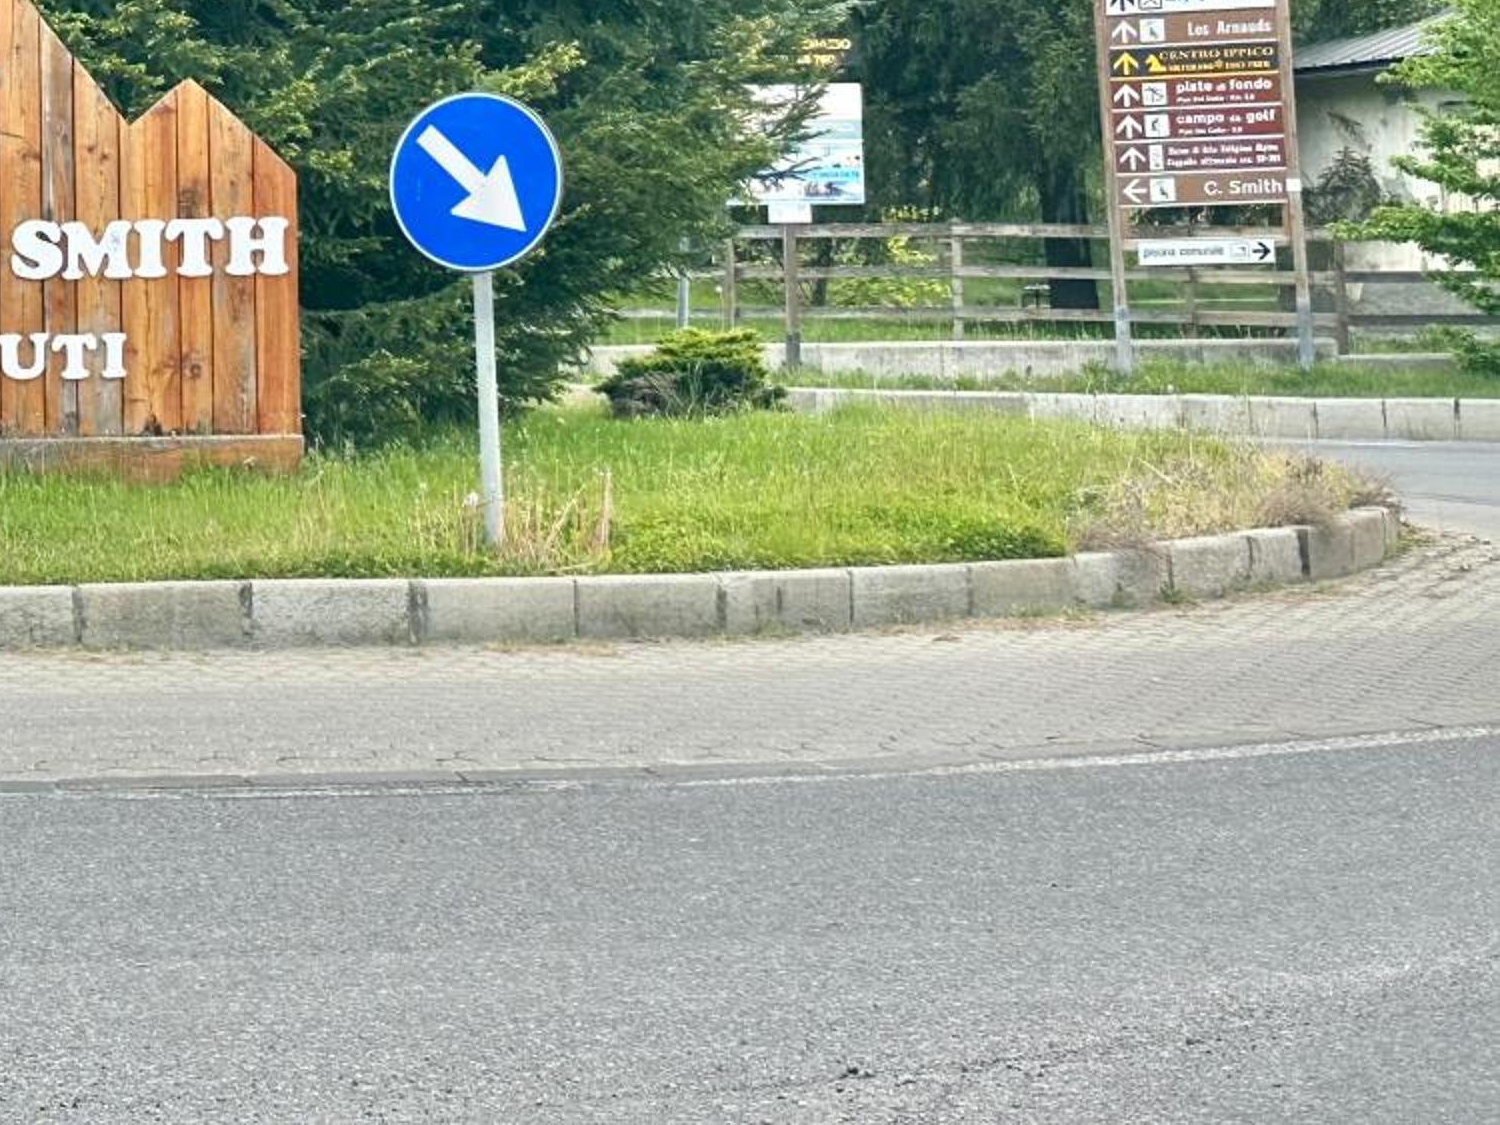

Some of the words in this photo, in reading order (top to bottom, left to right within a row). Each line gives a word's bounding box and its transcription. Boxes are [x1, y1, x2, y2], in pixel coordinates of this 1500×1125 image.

[1159, 49, 1221, 61] CENTRO
[1223, 45, 1274, 59] IPPICO
[1229, 77, 1273, 90] fondo
[1175, 113, 1225, 125] campo
[1245, 108, 1276, 124] golf
[1229, 177, 1283, 195] Smith
[11, 216, 290, 280] SMITH
